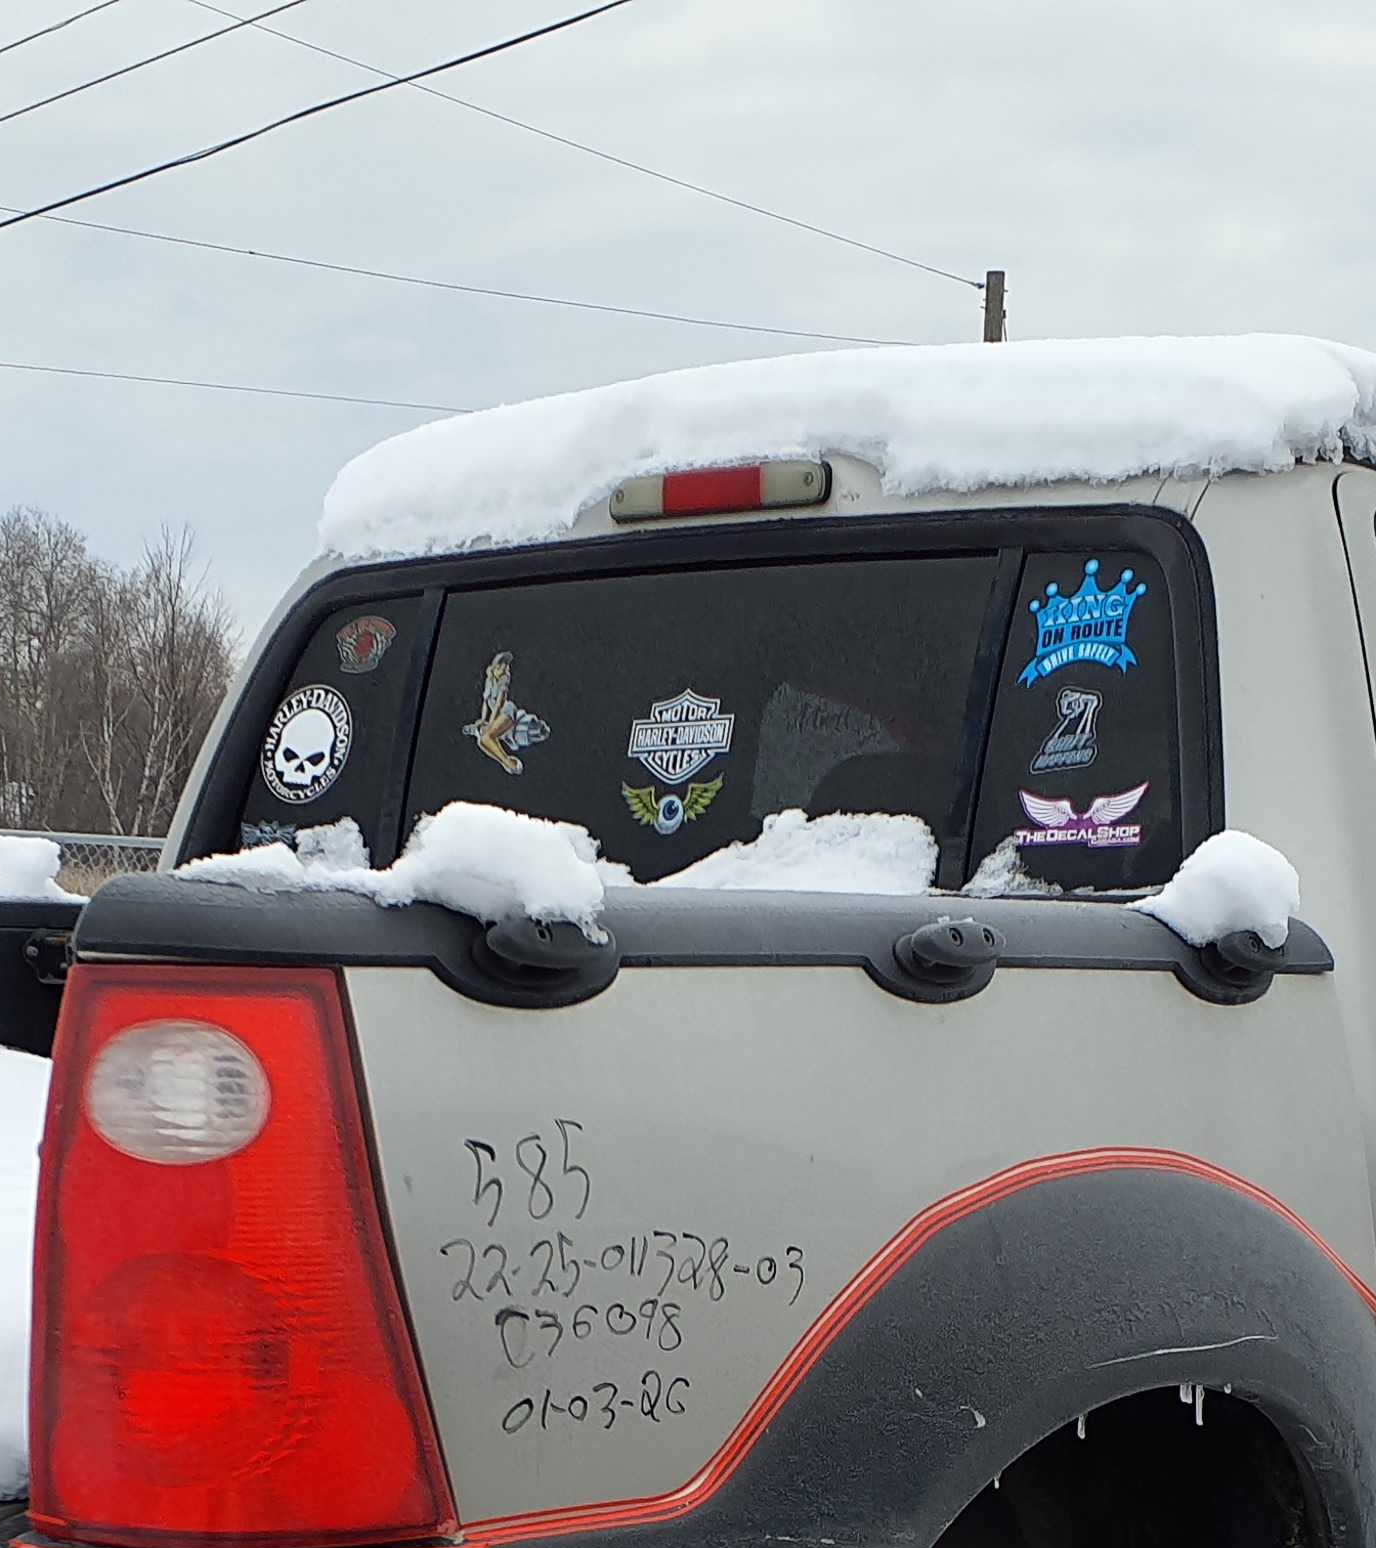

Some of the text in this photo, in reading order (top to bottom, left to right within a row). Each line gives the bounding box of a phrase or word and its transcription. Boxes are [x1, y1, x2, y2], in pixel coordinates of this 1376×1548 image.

[1044, 594, 1124, 627] KING
[1041, 618, 1123, 648] ON ROUTE
[1042, 643, 1116, 672] DRIVE SAFELY
[661, 700, 708, 722] MOTOR
[637, 722, 725, 748] HARLEY-DAVIDSON
[654, 750, 704, 774] CYCLES
[264, 760, 337, 801] MOTORCYCLES
[463, 1118, 591, 1228] 585
